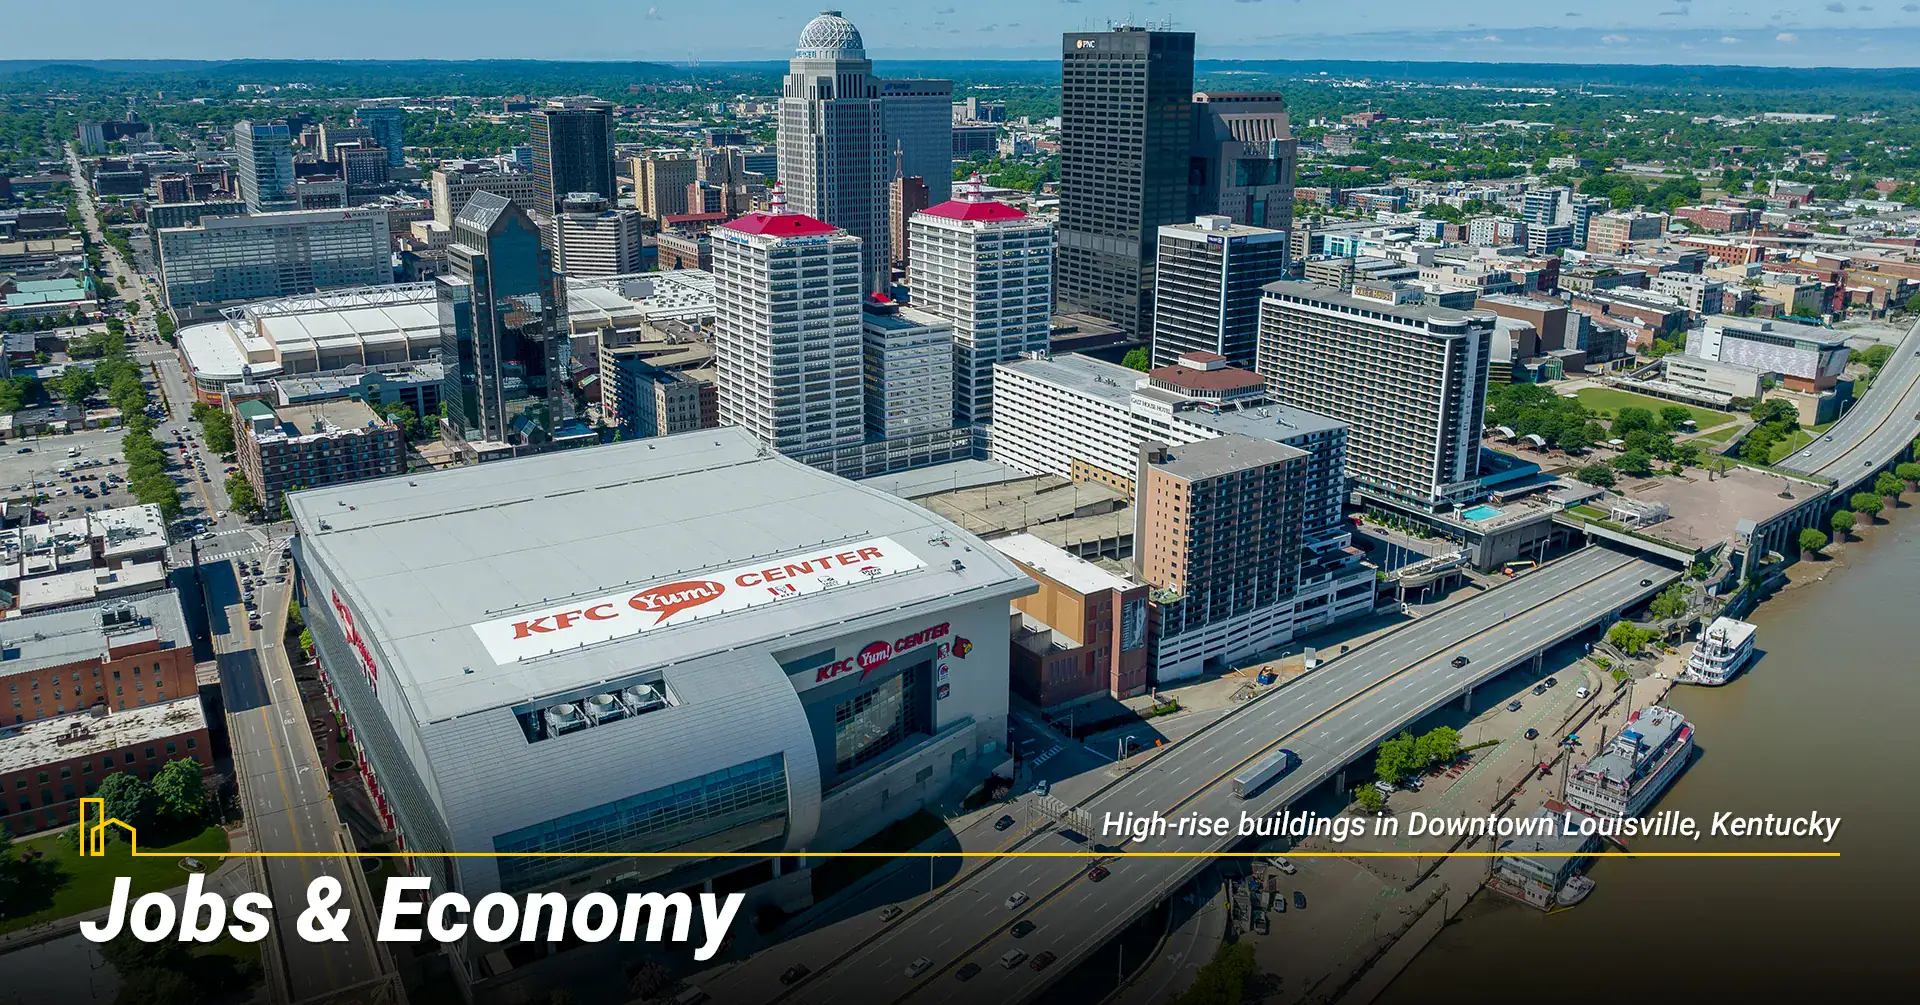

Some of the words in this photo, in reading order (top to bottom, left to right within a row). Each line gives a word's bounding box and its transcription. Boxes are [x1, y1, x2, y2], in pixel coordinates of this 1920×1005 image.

[1082, 40, 1096, 49] PNC
[511, 603, 619, 639] KFC
[632, 581, 720, 610] Yum!
[735, 547, 884, 587] CENTER
[816, 657, 854, 683] KFC
[861, 644, 891, 667] Yum!
[894, 622, 950, 653] CENTER
